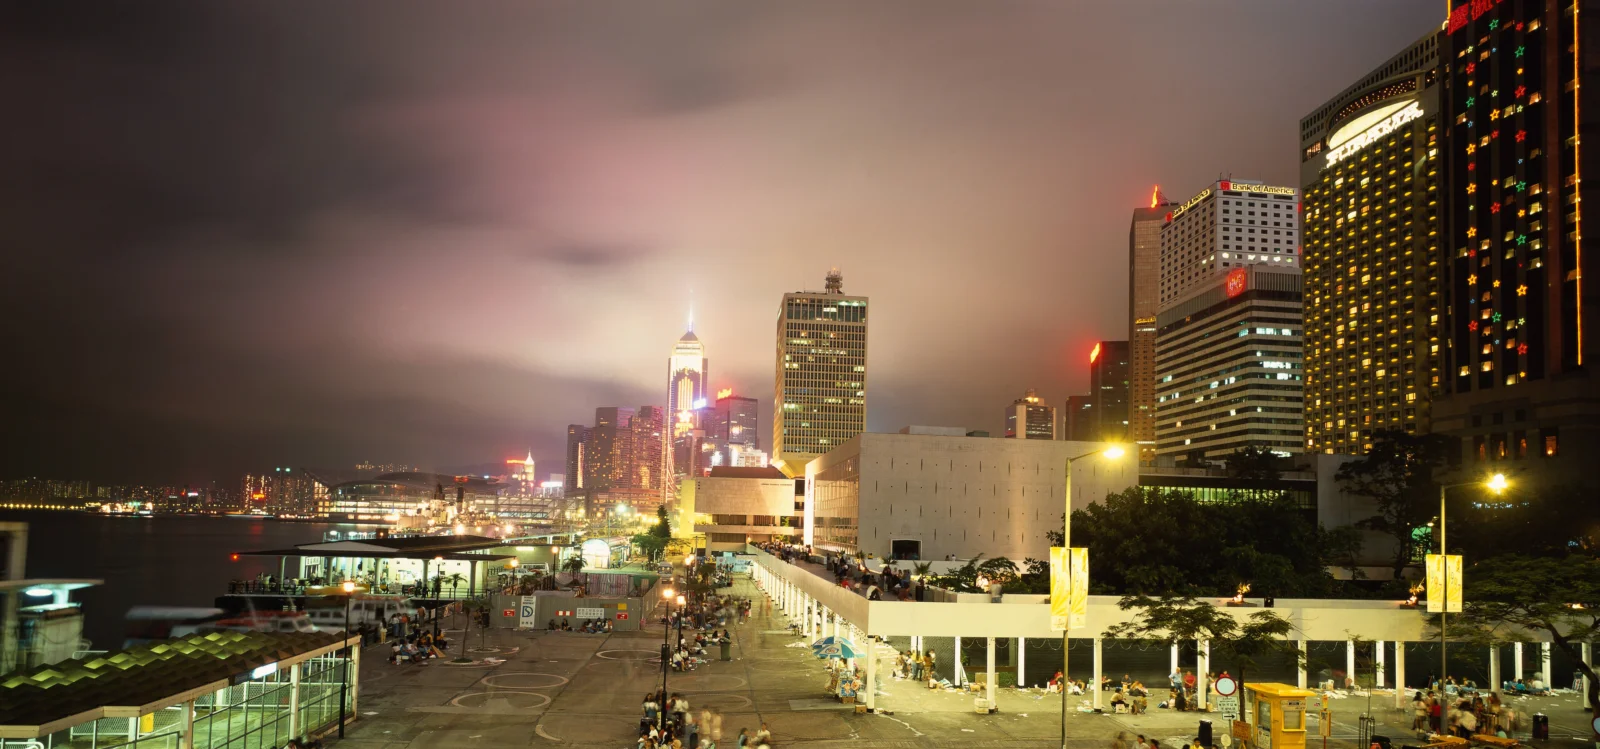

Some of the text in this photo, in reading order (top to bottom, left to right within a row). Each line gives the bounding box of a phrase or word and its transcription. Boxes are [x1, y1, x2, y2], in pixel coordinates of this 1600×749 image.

[1232, 183, 1295, 195] Bank of America
